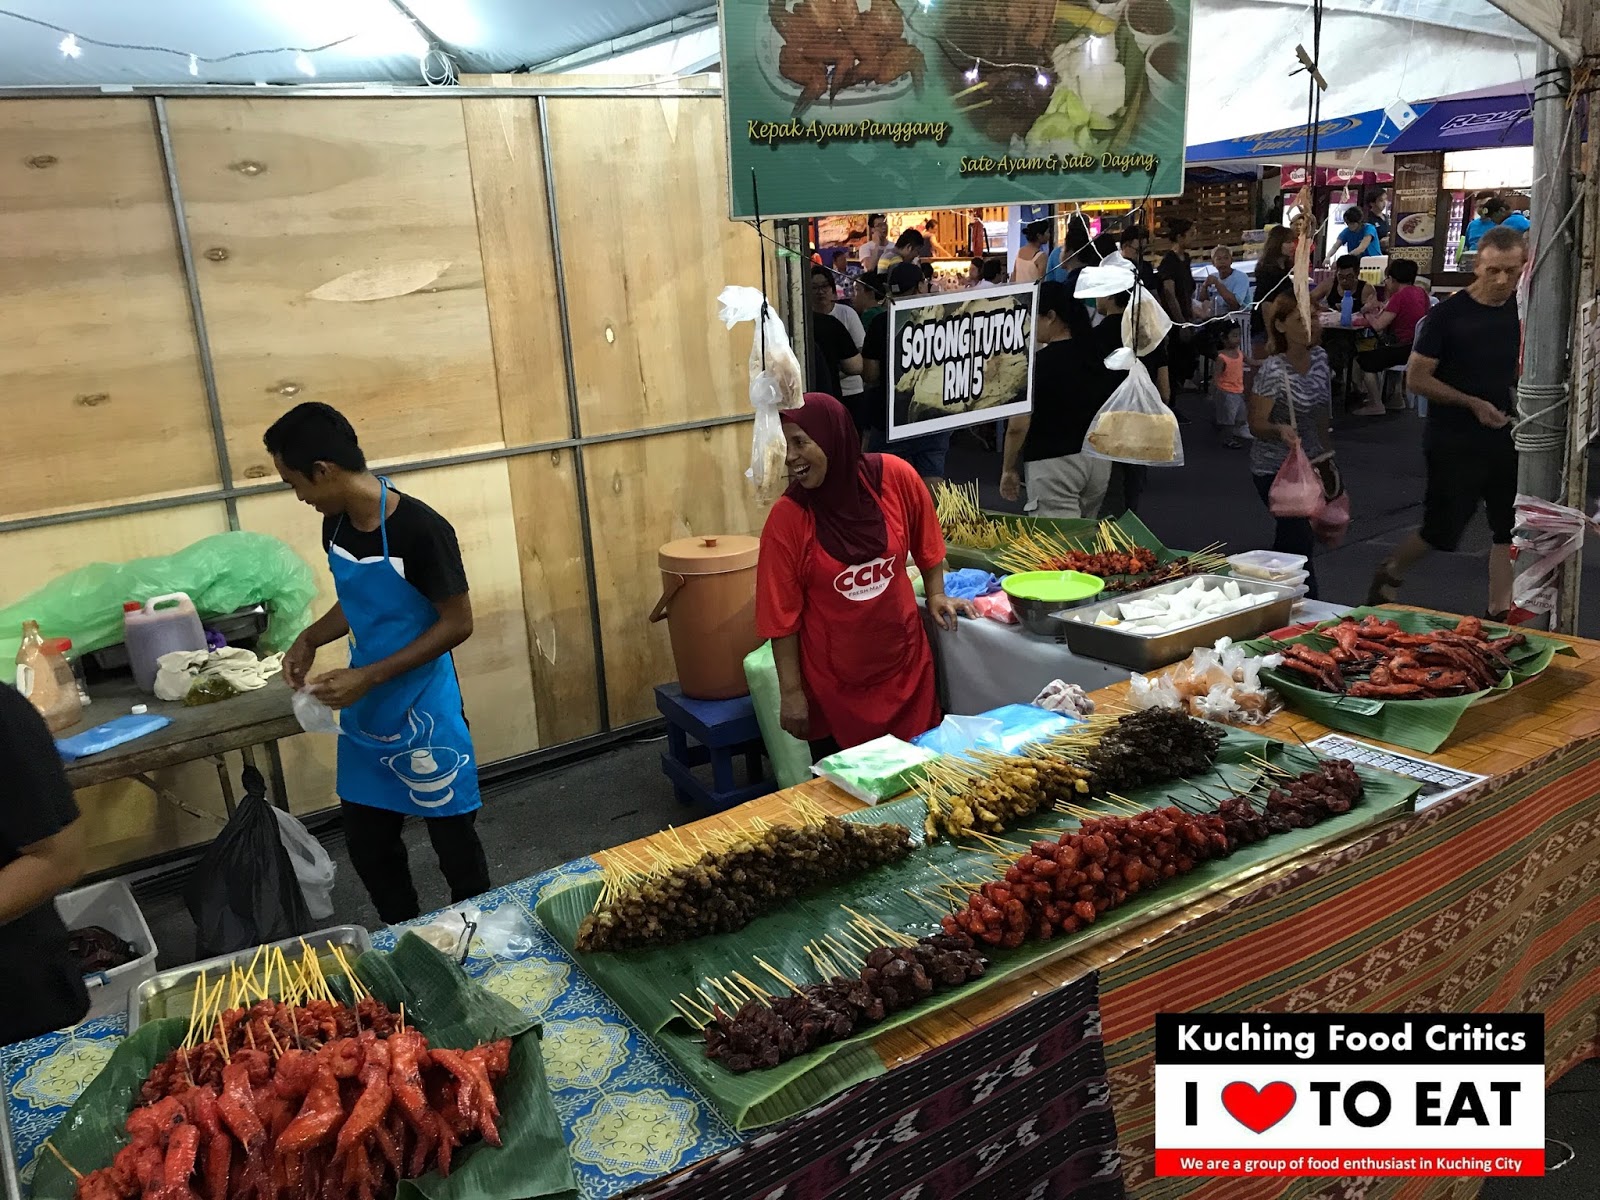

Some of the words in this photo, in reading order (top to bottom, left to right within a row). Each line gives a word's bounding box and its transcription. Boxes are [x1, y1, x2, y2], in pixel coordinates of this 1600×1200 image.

[748, 118, 804, 144] Kepak
[806, 119, 858, 142] Ayam
[860, 119, 947, 142] Panggang
[959, 155, 996, 173] Sate
[997, 154, 1044, 175] Ayam
[1046, 153, 1058, 171] &
[1061, 153, 1094, 170] Sate
[1101, 152, 1156, 172] Daging
[901, 316, 971, 369] SOTONG
[972, 307, 1027, 356] TUTOK
[943, 357, 971, 401] RM
[971, 355, 984, 396] 5
[835, 559, 894, 592] CCK
[848, 587, 869, 597] FRESH
